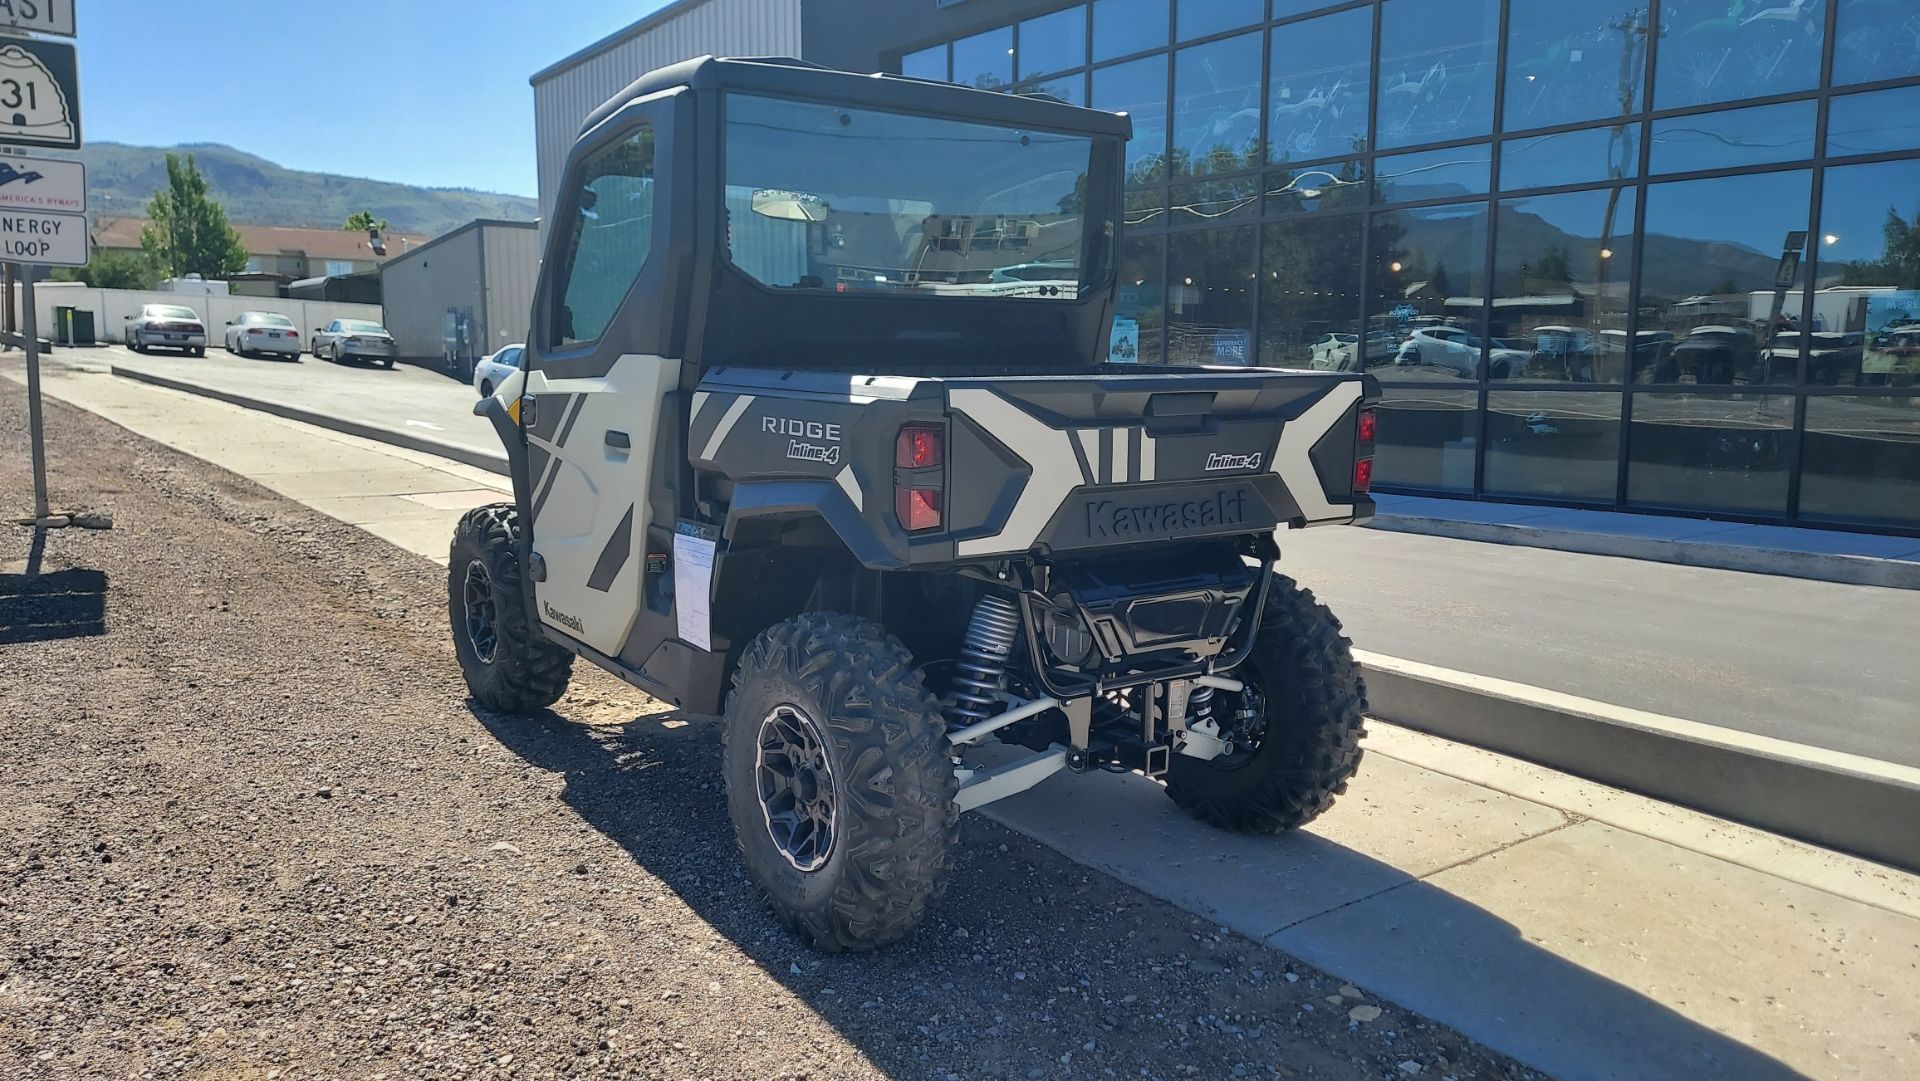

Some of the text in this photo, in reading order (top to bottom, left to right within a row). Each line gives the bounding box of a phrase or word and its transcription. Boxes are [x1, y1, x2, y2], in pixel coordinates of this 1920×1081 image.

[1, 78, 36, 110] 31
[0, 194, 80, 207] MERICA'S BYWAYS
[5, 240, 50, 256] LOOP
[1216, 346, 1244, 357] MORE
[762, 416, 841, 441] RIDGE
[787, 439, 840, 464] Inline-4
[1205, 452, 1262, 470] Inline-4
[1086, 490, 1248, 538] Kawasaki
[543, 600, 585, 635] Kawasaki
